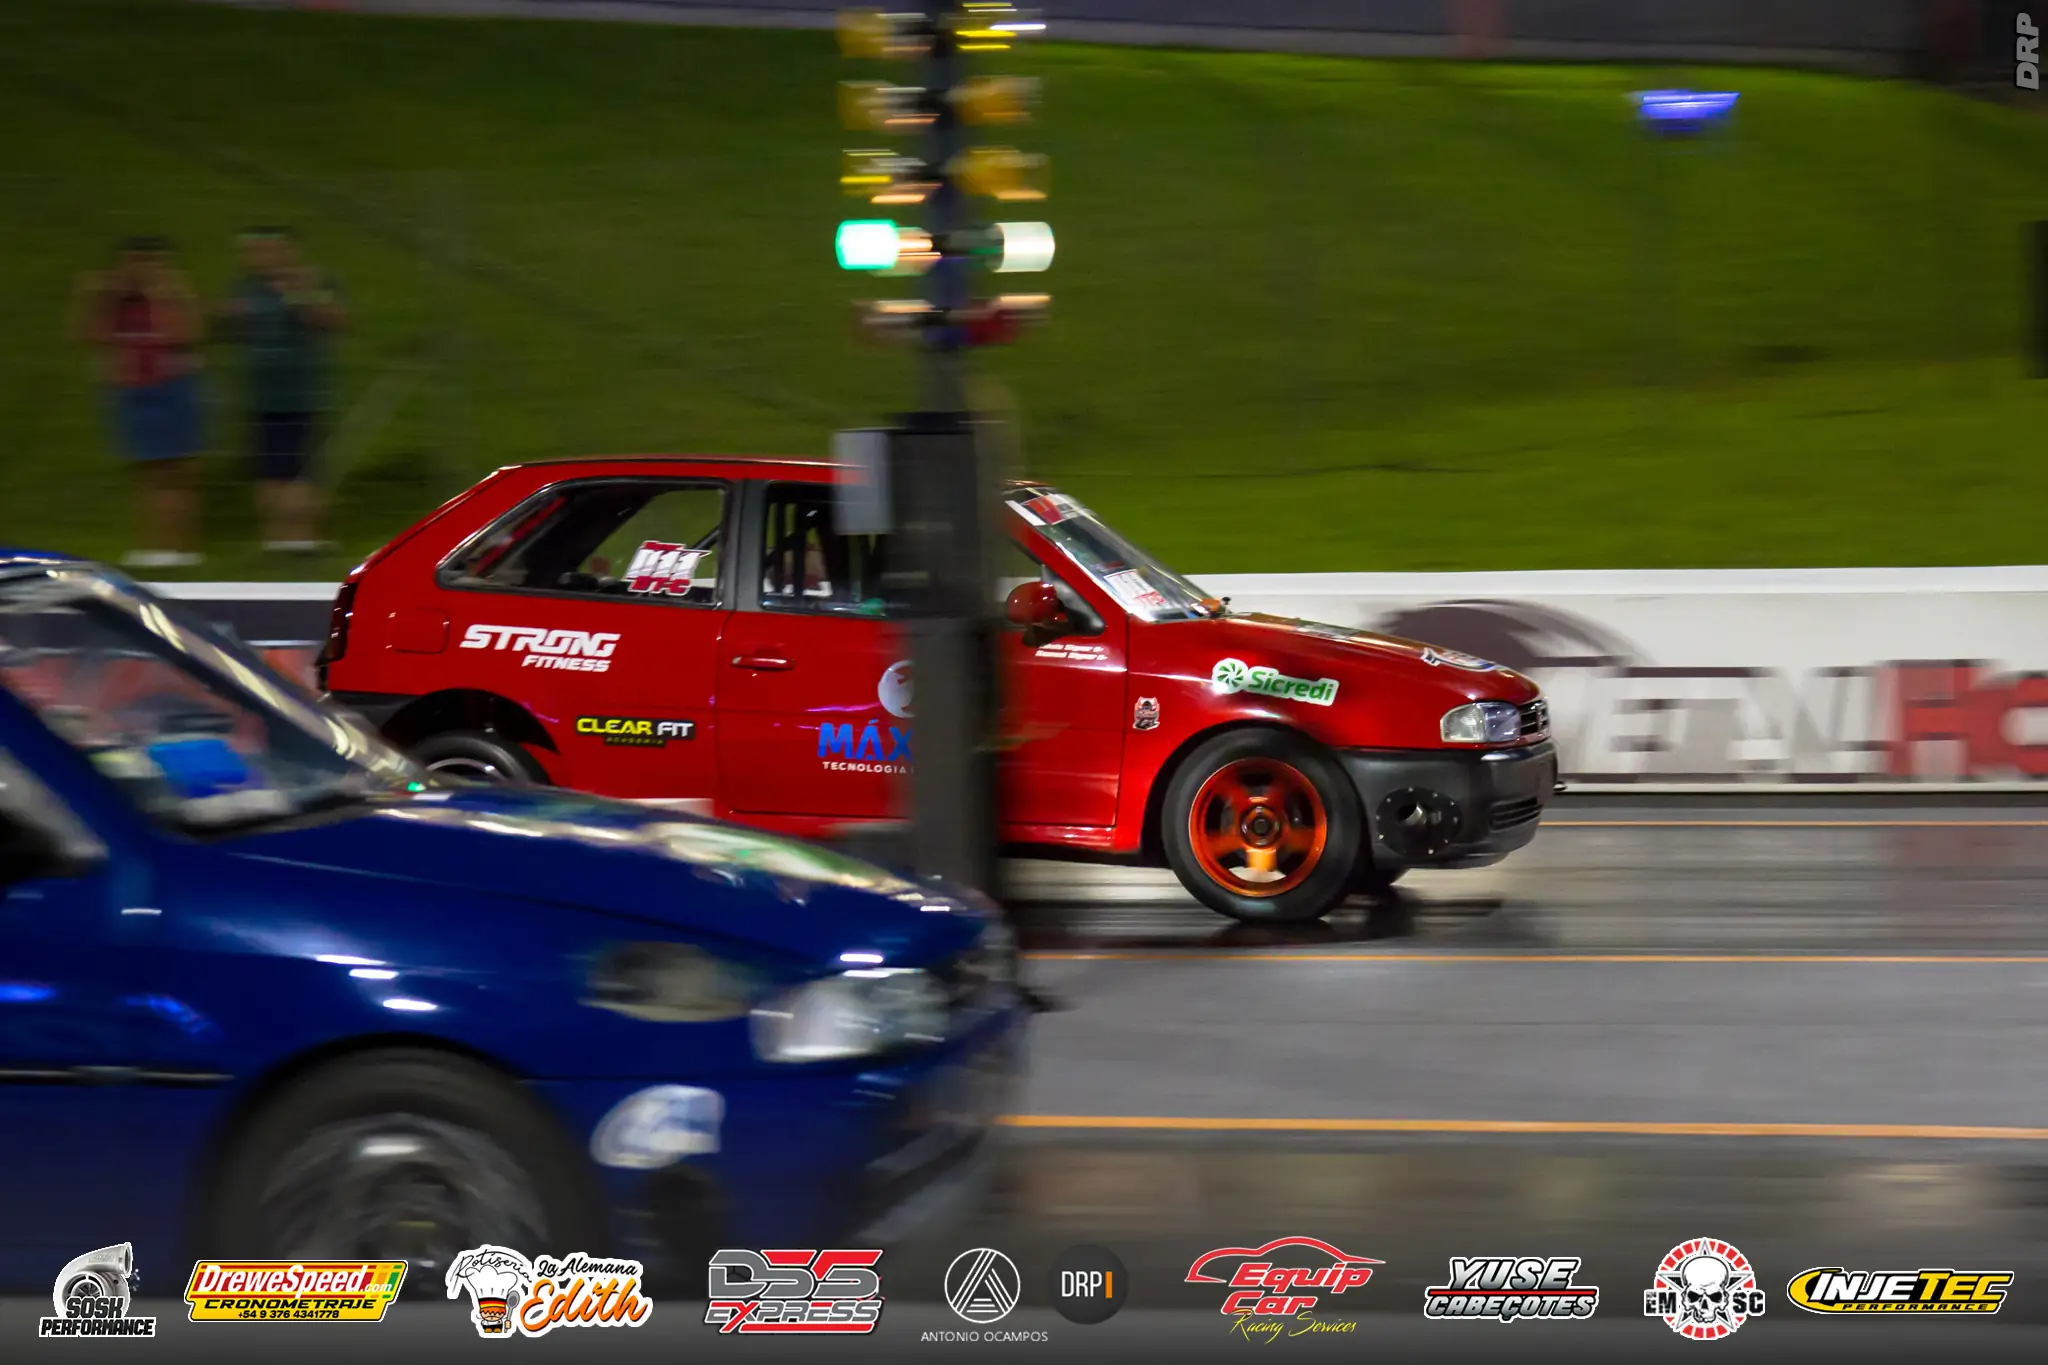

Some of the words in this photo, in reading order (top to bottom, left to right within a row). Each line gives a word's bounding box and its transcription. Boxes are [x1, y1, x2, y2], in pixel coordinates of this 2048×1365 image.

[459, 624, 621, 657] STRONG
[521, 655, 611, 672] FITNESS
[1247, 669, 1334, 702] Sicredi
[577, 718, 653, 735] CLEAR
[657, 721, 694, 737] FIT
[822, 761, 906, 774] TECNOLOGIA
